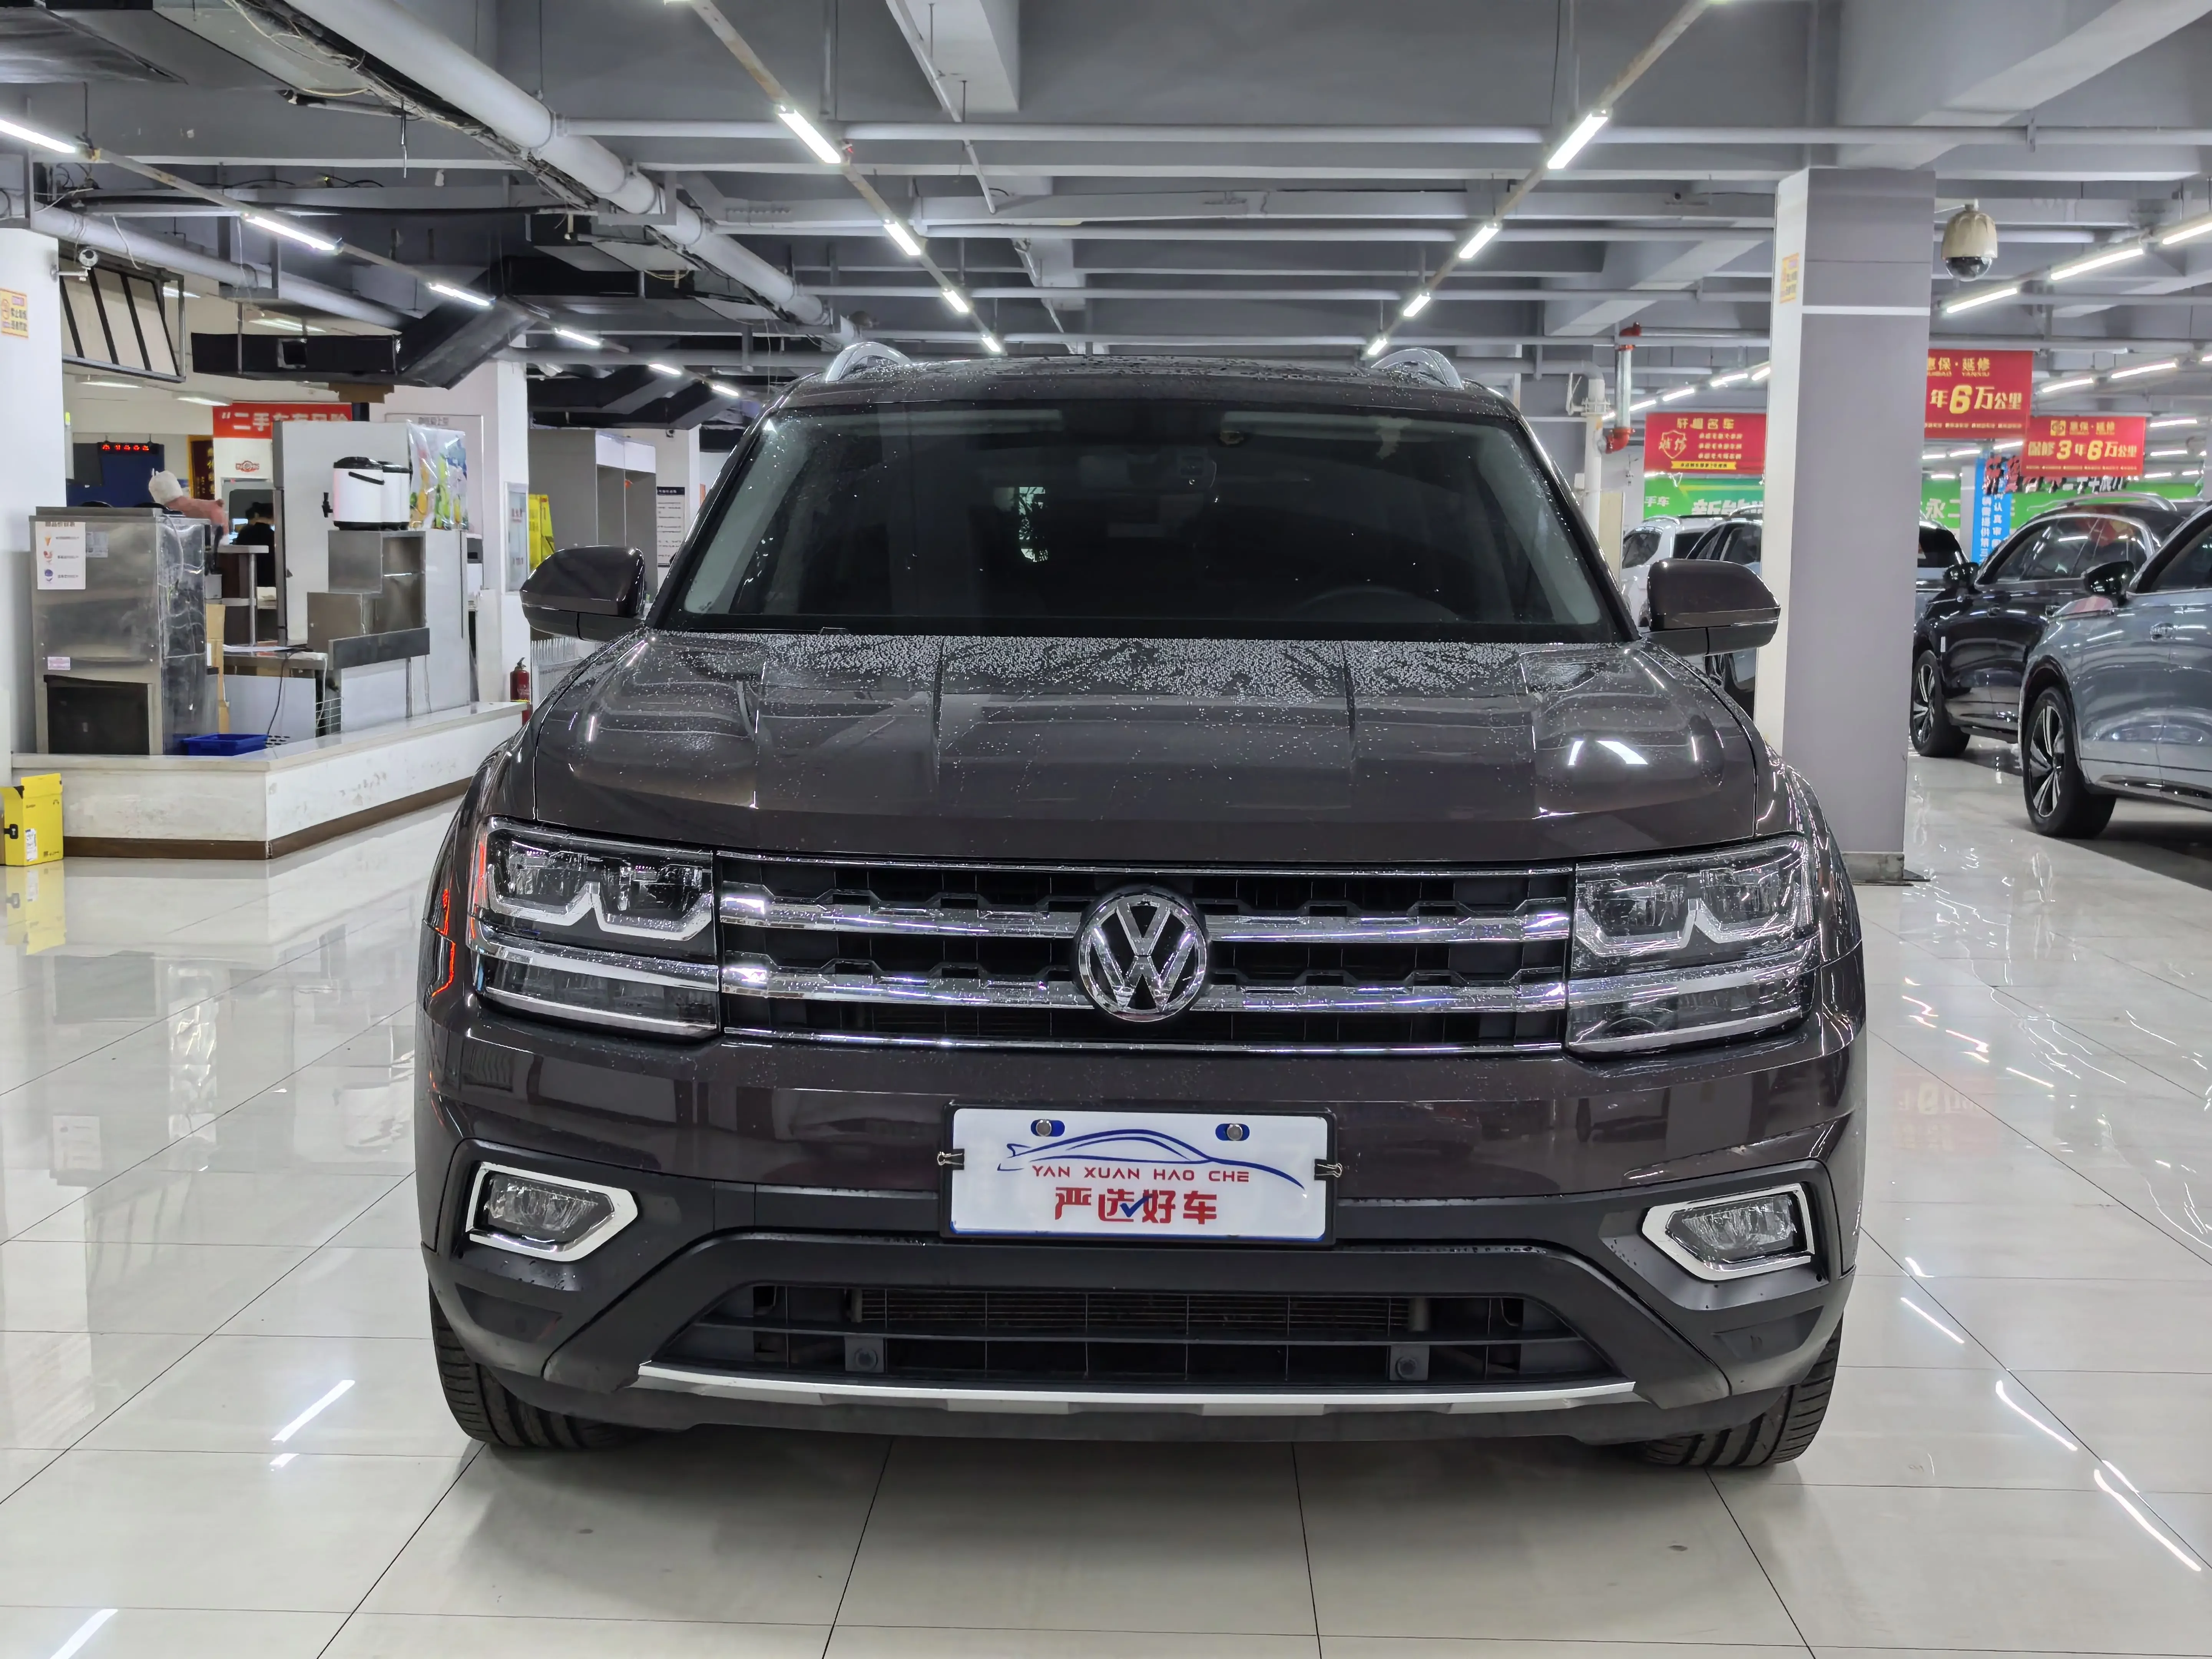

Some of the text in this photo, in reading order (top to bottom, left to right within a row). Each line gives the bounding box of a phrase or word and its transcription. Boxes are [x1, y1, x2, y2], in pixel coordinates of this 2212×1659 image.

[1930, 384, 2022, 414] 年6万公里
[1032, 1166, 1249, 1182] YAN XUAN HAO CHE
[1055, 1187, 1217, 1225] 严选好车
